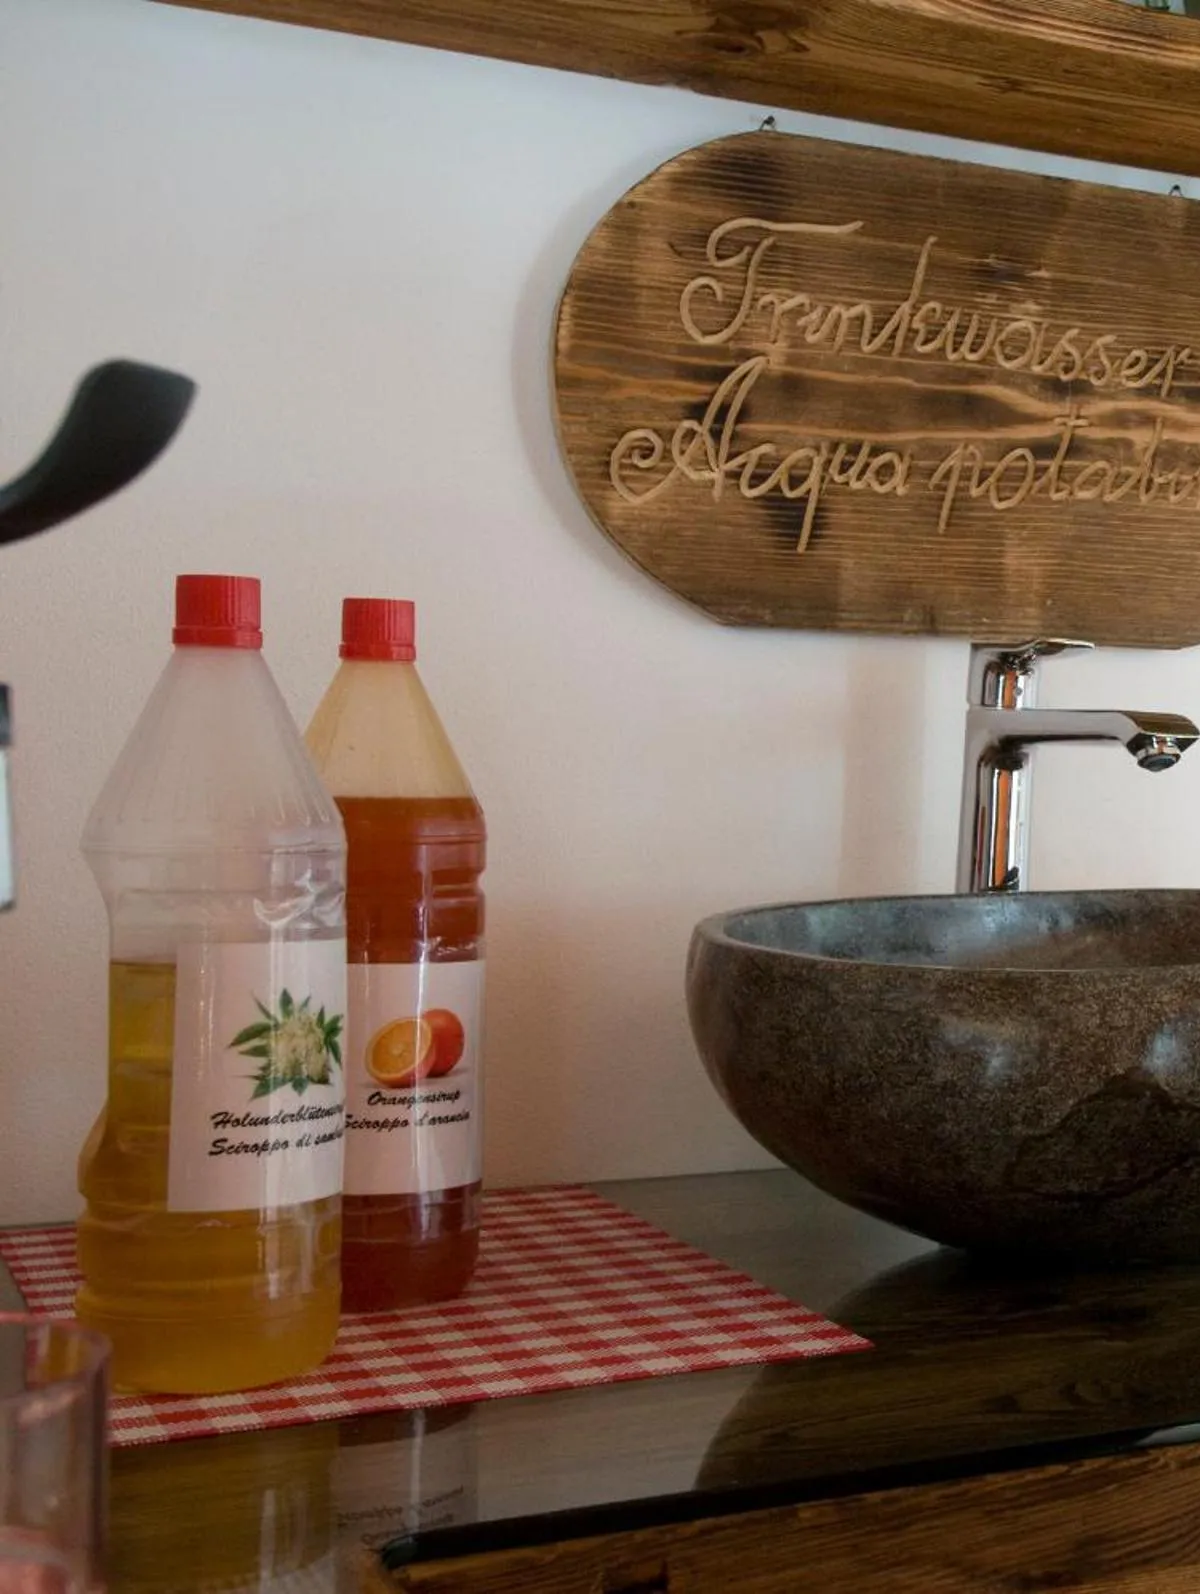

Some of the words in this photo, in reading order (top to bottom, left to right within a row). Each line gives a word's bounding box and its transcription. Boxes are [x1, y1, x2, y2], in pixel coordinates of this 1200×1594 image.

[680, 217, 1192, 398] Trinkwasser
[610, 355, 910, 553] Acqua
[208, 1138, 289, 1157] Sciroppo
[296, 1133, 312, 1148] di
[345, 1114, 410, 1132] Sciroppo
